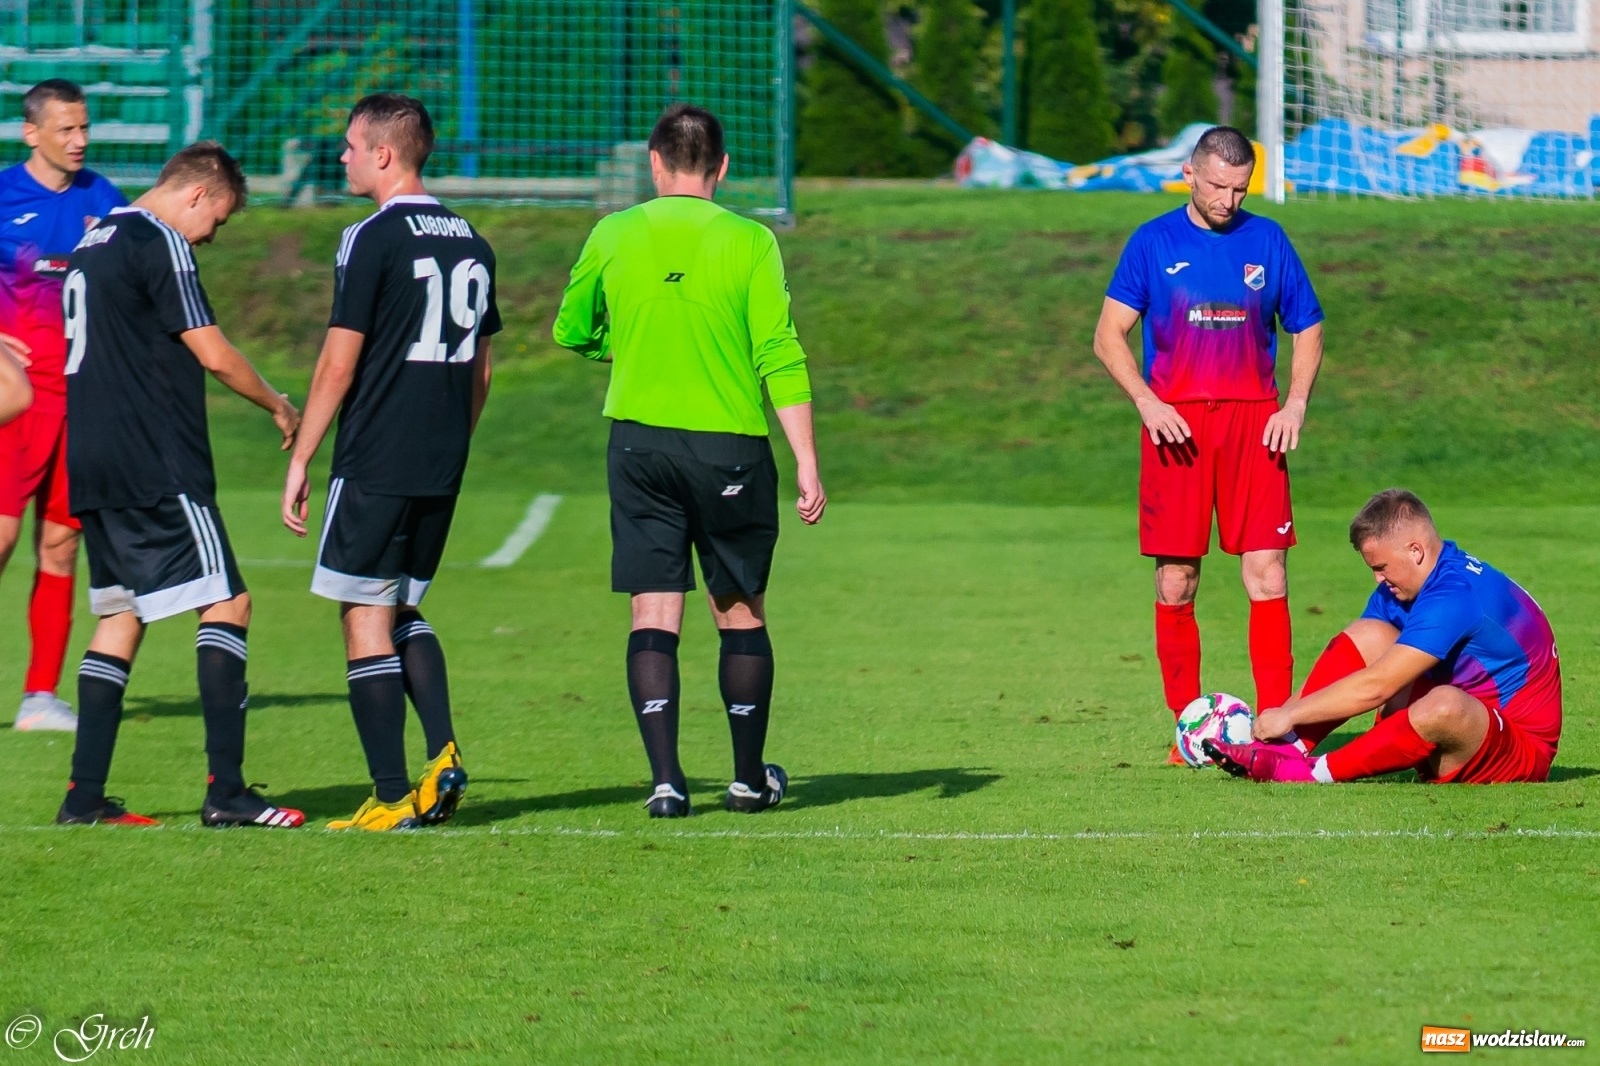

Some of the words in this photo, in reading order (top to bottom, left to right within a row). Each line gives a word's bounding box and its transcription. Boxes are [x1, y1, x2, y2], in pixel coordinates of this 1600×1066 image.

[405, 214, 473, 239] LUBOMIA
[62, 268, 87, 375] 9
[405, 257, 490, 363] 19
